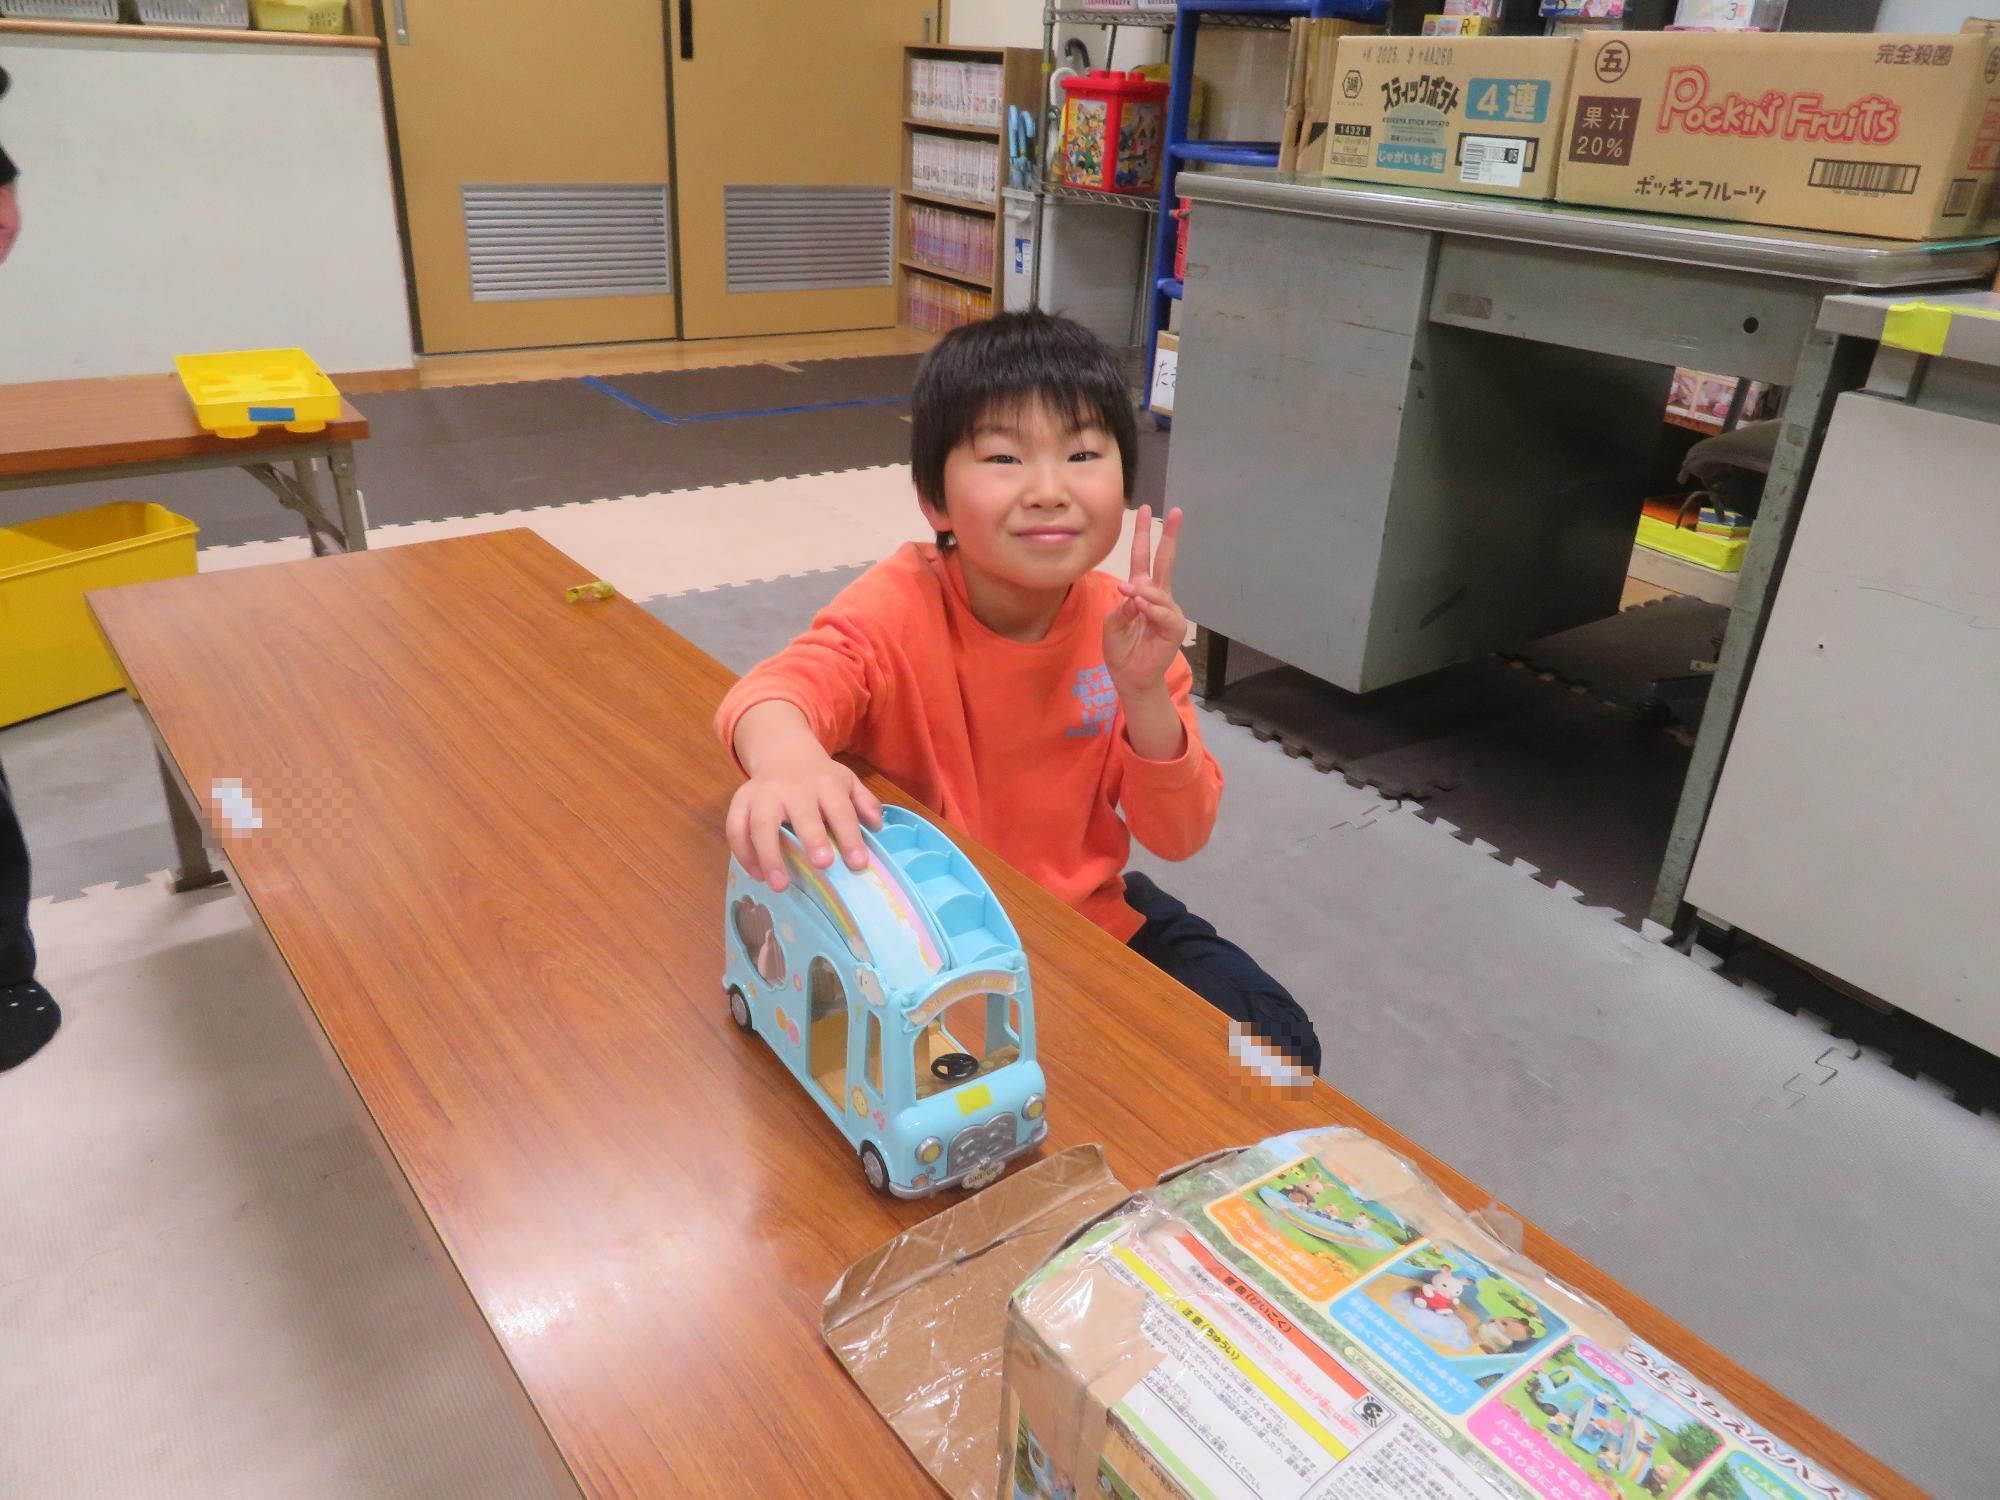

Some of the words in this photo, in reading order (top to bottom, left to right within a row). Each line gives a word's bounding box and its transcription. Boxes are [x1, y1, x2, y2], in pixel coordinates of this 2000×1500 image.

[1875, 43, 1954, 66] 完全殺菌
[1381, 75, 1459, 115] スティックポテト
[1475, 82, 1538, 120] 4連
[1340, 125, 1367, 136] 14321
[1575, 136, 1624, 158] 20%
[1634, 175, 1767, 204] ポッキンフルーツ
